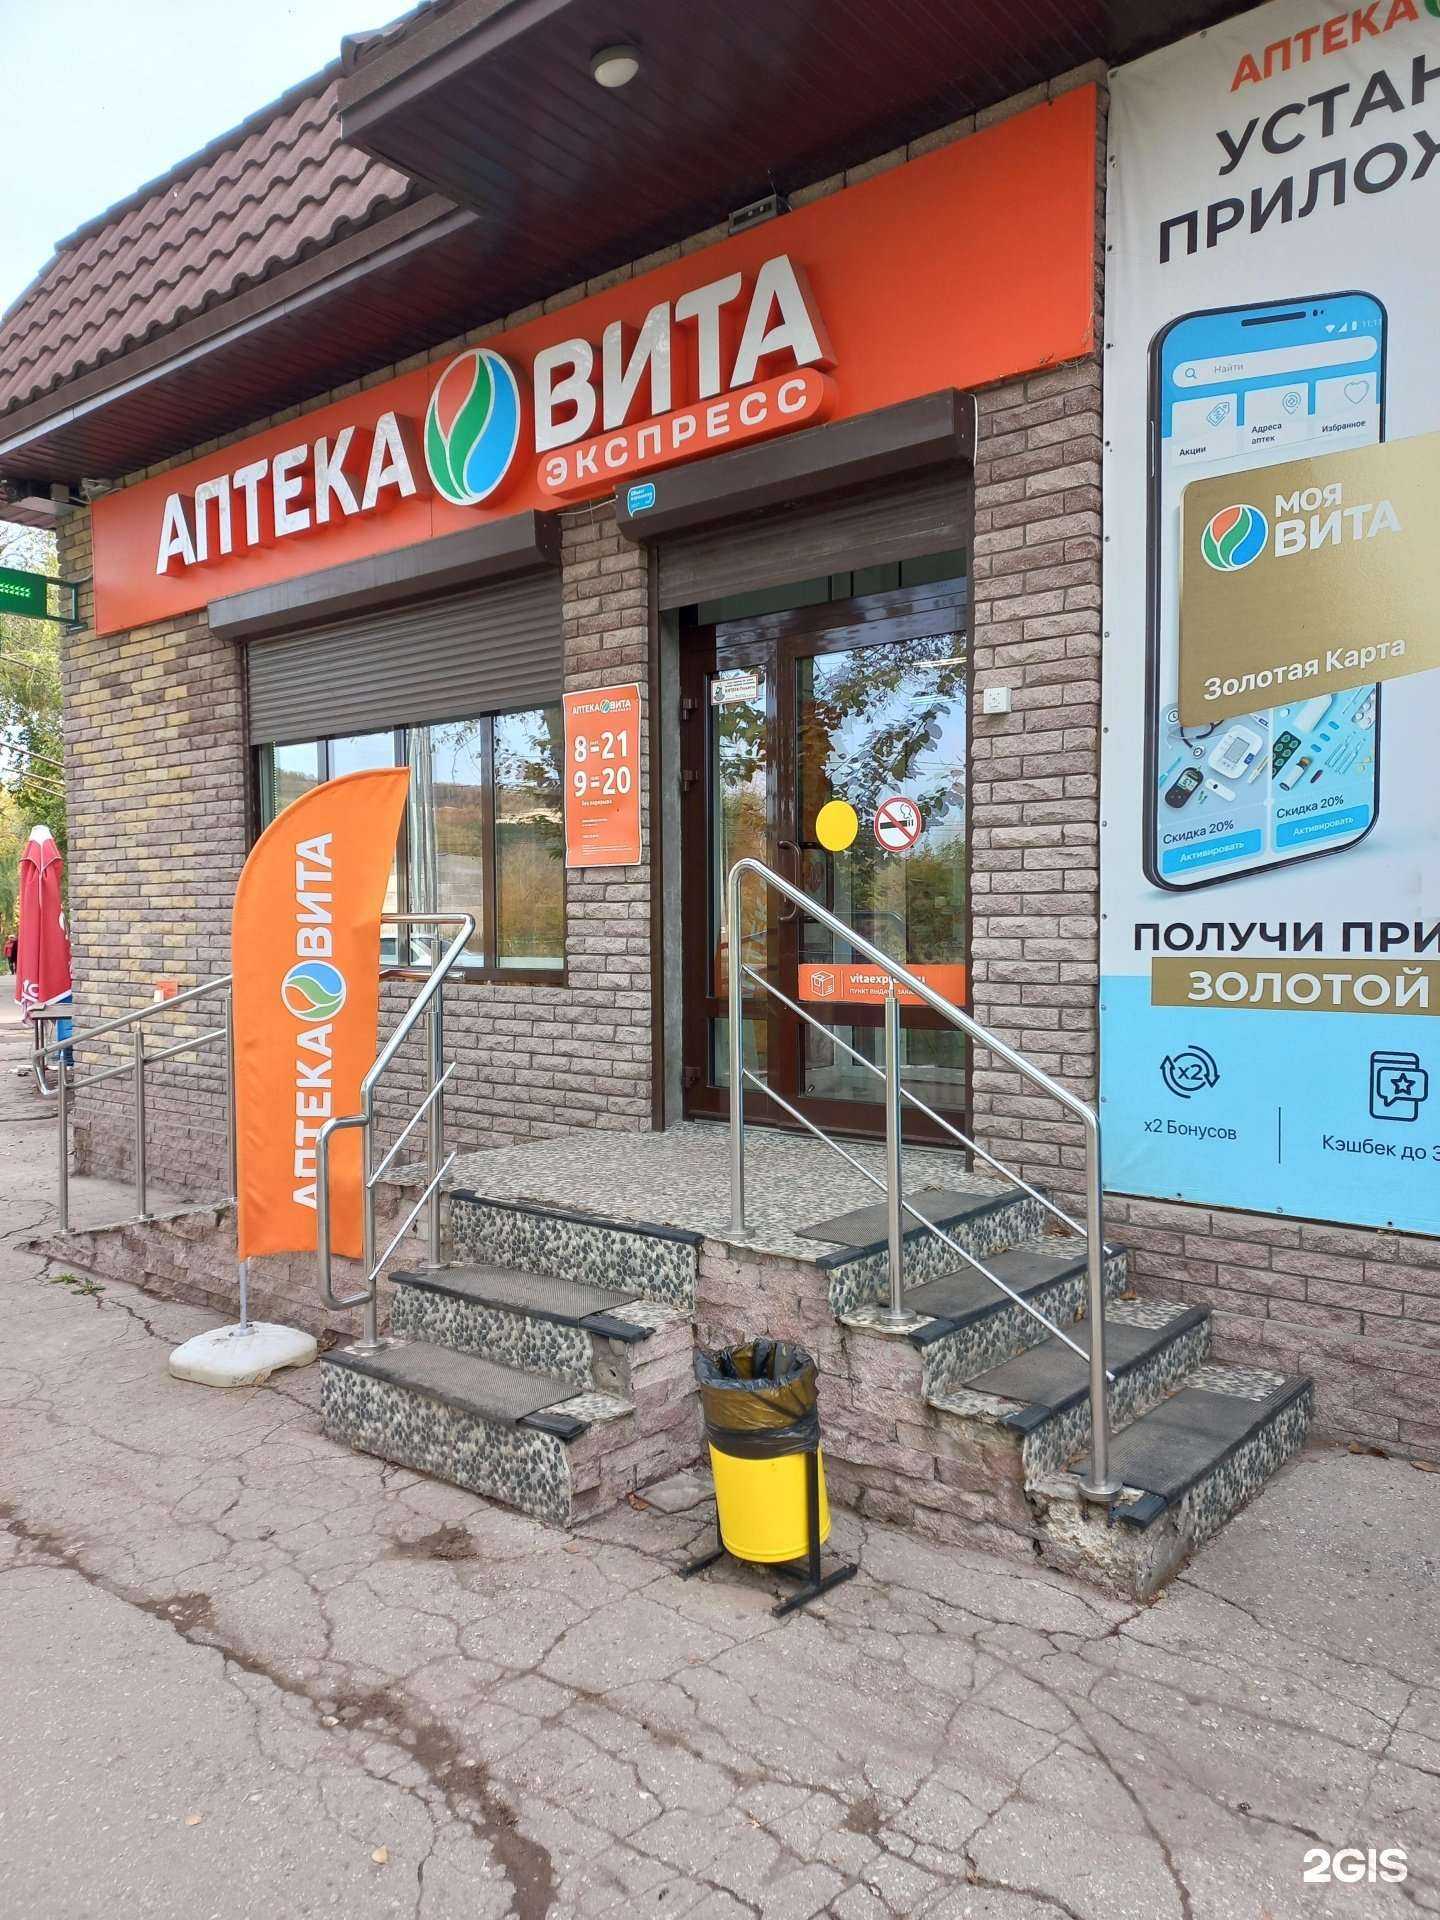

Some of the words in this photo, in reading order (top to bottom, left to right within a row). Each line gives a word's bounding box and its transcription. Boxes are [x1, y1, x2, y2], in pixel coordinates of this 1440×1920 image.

[1230, 0, 1419, 92] АПТЕКА
[1214, 364, 1245, 375] Найти
[155, 411, 417, 575] АПТЕКА
[534, 254, 823, 453] ВИТА
[1251, 422, 1282, 434] Адреса
[1321, 419, 1366, 433] Избранное
[546, 377, 808, 487] ЭКСПРЕСС
[1251, 435, 1275, 445] аптек
[1179, 446, 1207, 457] Акции
[1275, 483, 1342, 517] МОЯ
[1275, 500, 1401, 558] ВИТА
[1203, 658, 1318, 701] Золотая
[1325, 639, 1406, 672] Карта
[573, 704, 600, 715] АПТЕКА
[610, 700, 631, 710] ВИТА
[1277, 803, 1318, 819] Скидка
[1320, 795, 1344, 809] 20%
[1163, 828, 1207, 845] Скидка
[1209, 819, 1234, 834] 20%
[1293, 816, 1354, 836] Активировать
[1180, 841, 1244, 863] Активировать
[296, 832, 333, 958] ВИТА
[1134, 922, 1323, 951] ПОЛУЧИ
[1187, 967, 1429, 1008] ЗОЛОТОЙ
[293, 1023, 333, 1211] АПТЕКА
[1167, 1119, 1237, 1141] Бонусов
[1322, 1134, 1397, 1158] Кэшбек
[1401, 1145, 1427, 1162] до
